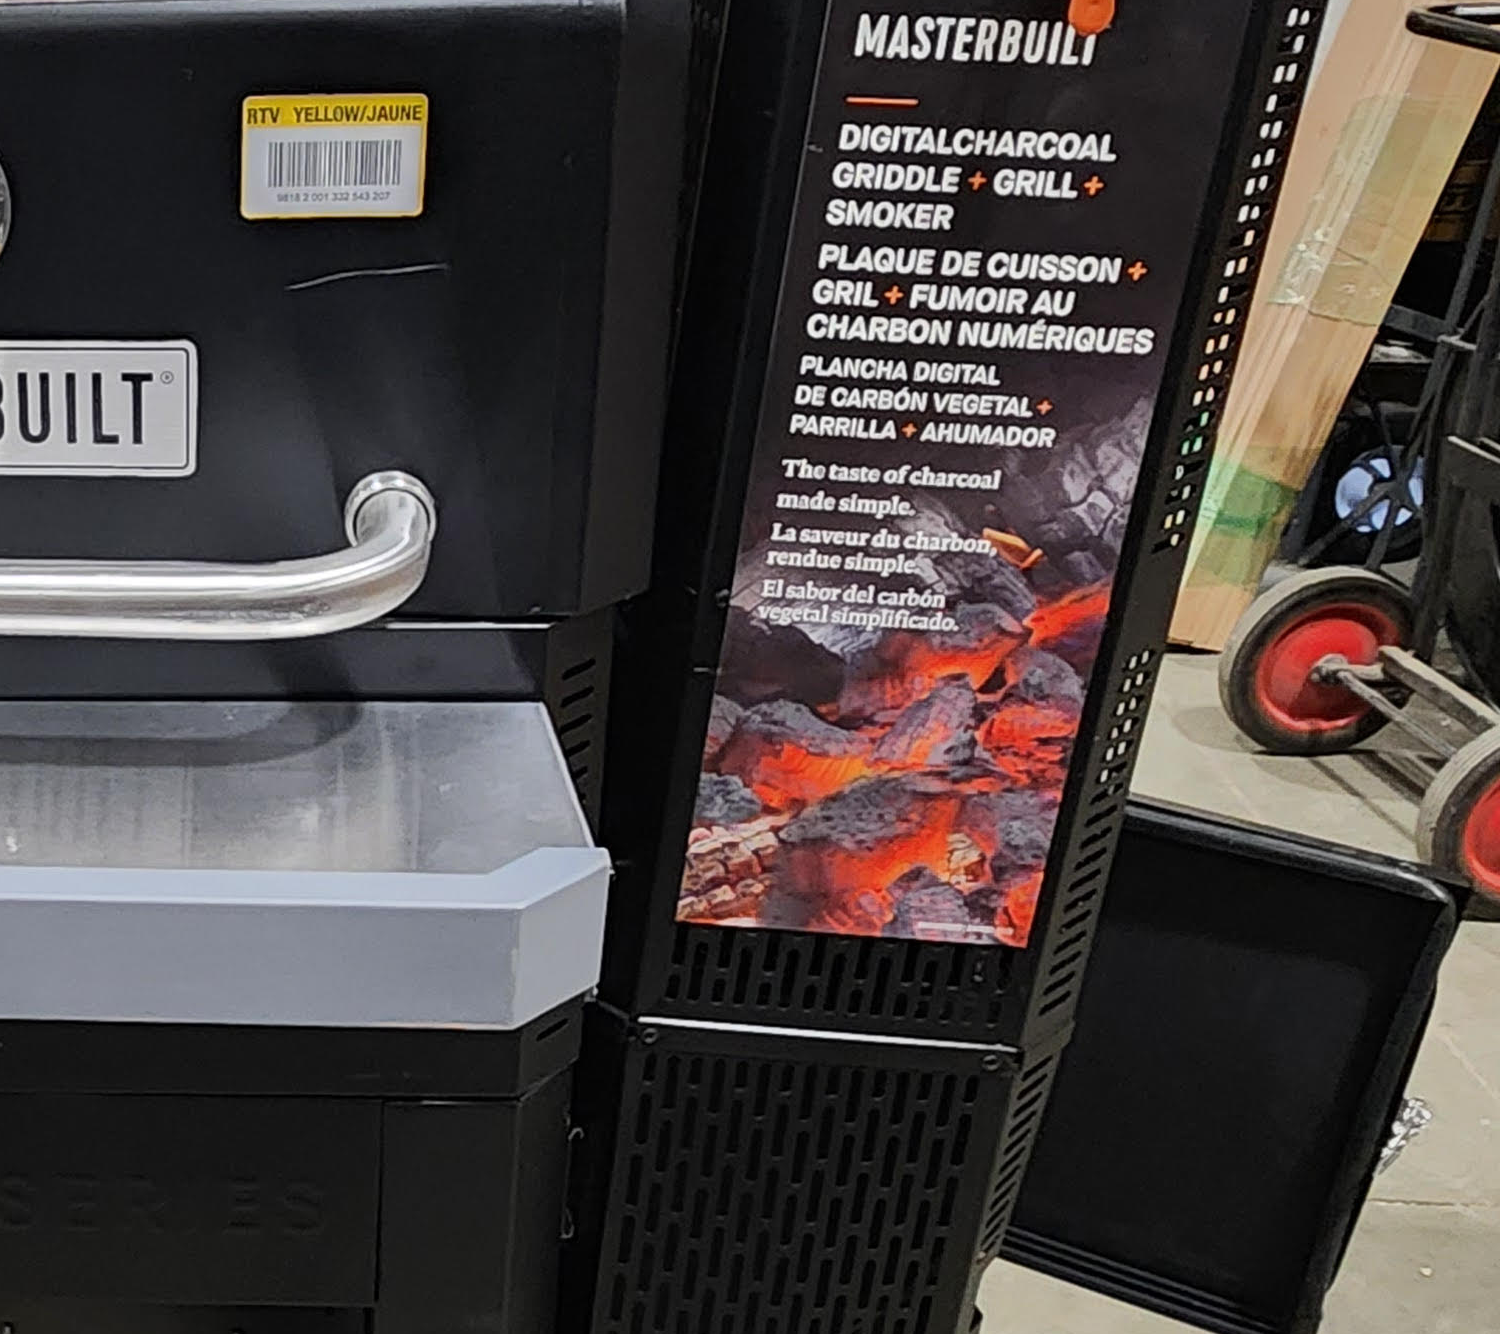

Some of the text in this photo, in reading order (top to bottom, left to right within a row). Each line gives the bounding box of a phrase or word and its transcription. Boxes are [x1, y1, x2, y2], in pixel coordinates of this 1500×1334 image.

[247, 104, 423, 124] RTV YELLOW/JAUNE
[831, 162, 963, 193] GRIDDLE
[993, 169, 1079, 199] GRILL
[825, 198, 955, 231] SMOKER
[817, 243, 936, 276] PLAQUE
[940, 250, 982, 278] DE
[986, 252, 1122, 284] CUISSON
[812, 279, 880, 308] GRIL
[909, 284, 1027, 316] FUMOIR
[1031, 289, 1077, 317] AU
[806, 313, 1155, 355] CHARBON NUMÉRIQUES
[800, 354, 1001, 386] PLANCHA DIGITAL
[794, 384, 826, 407] DE
[830, 384, 928, 413] CARBÓN
[933, 391, 1034, 418] VEGETAL
[789, 414, 897, 440] PARRILLA
[920, 420, 1056, 448] AHUMADOR
[782, 458, 1002, 490] The taste of charcoal
[776, 490, 917, 519] made simple.
[770, 522, 998, 557] La saveur du charbon,
[766, 548, 842, 570] rendue
[761, 578, 946, 610] El sabor del carbón
[757, 604, 960, 632] vegetal simplificado.
